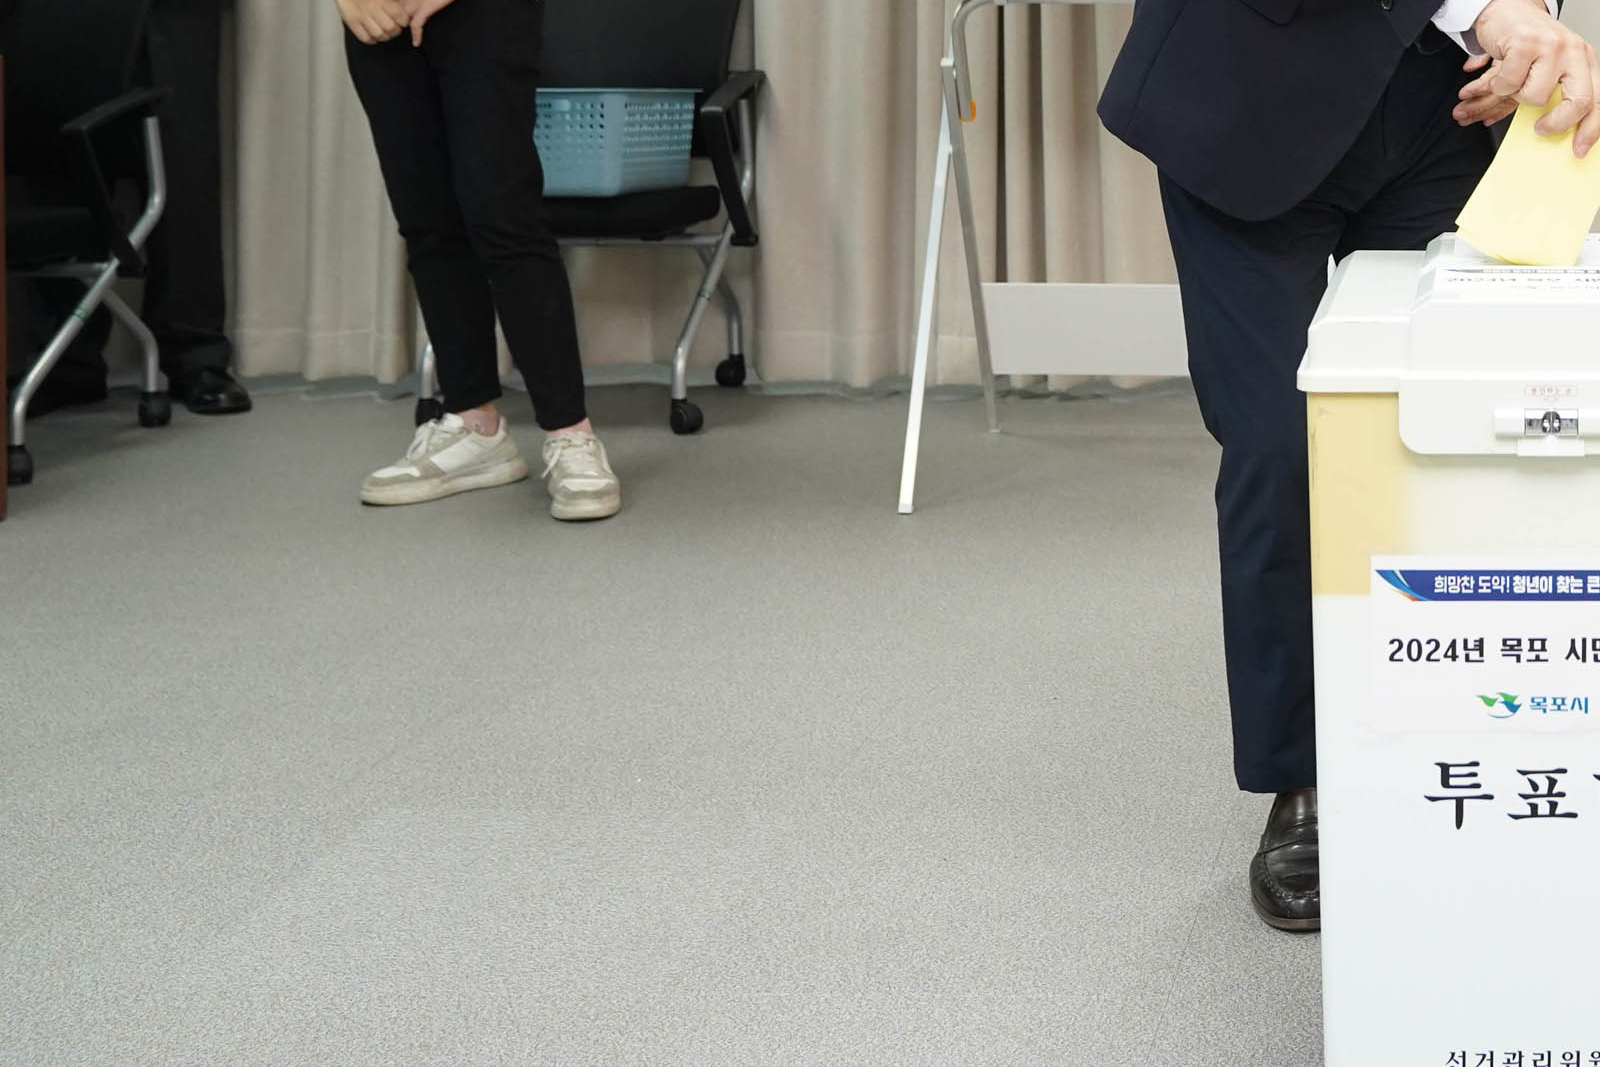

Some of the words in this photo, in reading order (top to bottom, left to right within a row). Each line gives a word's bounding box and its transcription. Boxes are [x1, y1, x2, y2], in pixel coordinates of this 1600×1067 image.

[1434, 576, 1475, 594] 희망찬
[1478, 576, 1510, 594] 도약!
[1513, 576, 1553, 594] 청년이
[1557, 576, 1583, 594] 찾는
[1587, 576, 1600, 594] 큰
[1389, 637, 1485, 663] 2024년
[1500, 638, 1549, 663] 목포
[1528, 696, 1588, 714] 목포시
